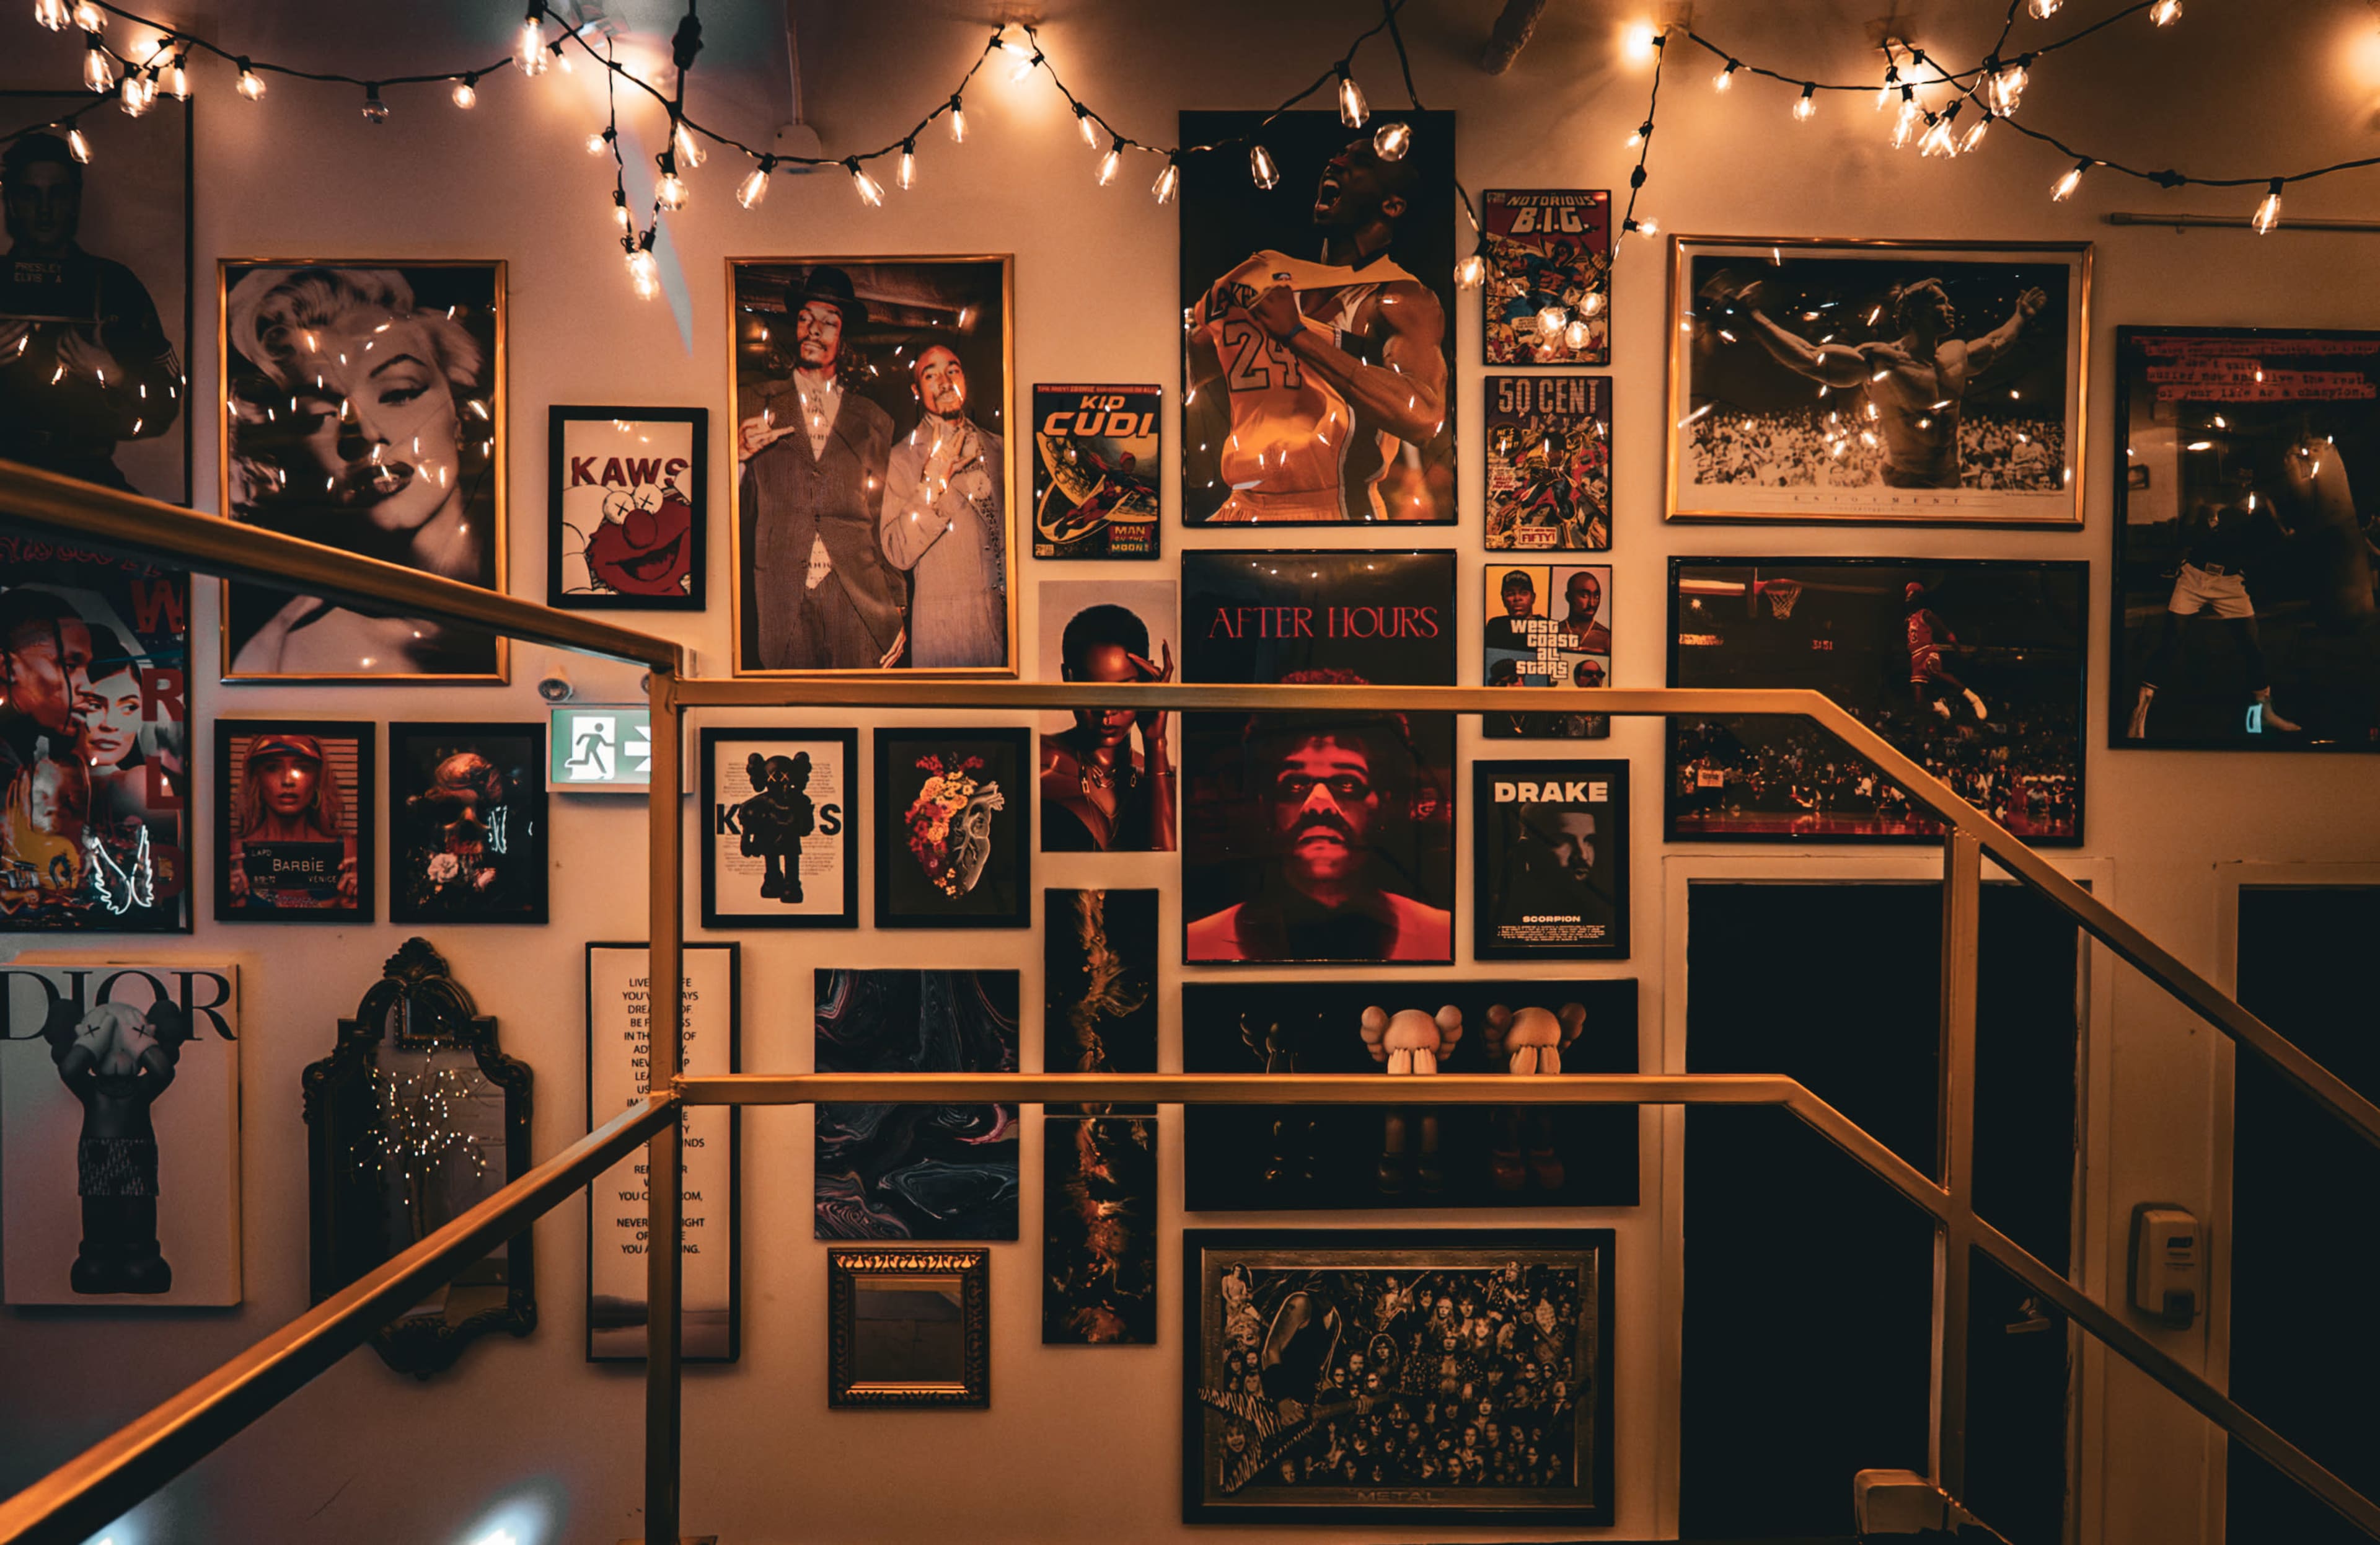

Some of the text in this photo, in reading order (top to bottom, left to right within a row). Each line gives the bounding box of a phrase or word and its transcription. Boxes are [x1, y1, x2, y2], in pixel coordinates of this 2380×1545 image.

[1506, 195, 1597, 206] NOTORIOUS
[1510, 207, 1589, 233] B.I.G.
[1223, 319, 1302, 392] 24
[1498, 378, 1600, 414] 50 CENT
[1080, 395, 1126, 410] KID
[1043, 412, 1155, 436] CUDI
[571, 457, 688, 487] KAWS
[1115, 525, 1145, 535] MAN
[1207, 606, 1439, 639] AFTER HOURS
[1494, 781, 1608, 802] DRAKE
[251, 849, 272, 857] LAPD
[308, 875, 337, 883] VENICE
[1522, 915, 1581, 923] SCORPION
[629, 978, 650, 987] LIVE
[0, 970, 238, 1040] DIOR
[630, 1019, 642, 1027] BE
[624, 1032, 697, 1040] IN TH OF
[619, 1192, 640, 1201] YOU
[617, 1218, 648, 1227] NEVER
[622, 1245, 643, 1254] YOU
[1357, 1490, 1440, 1502] METAL
